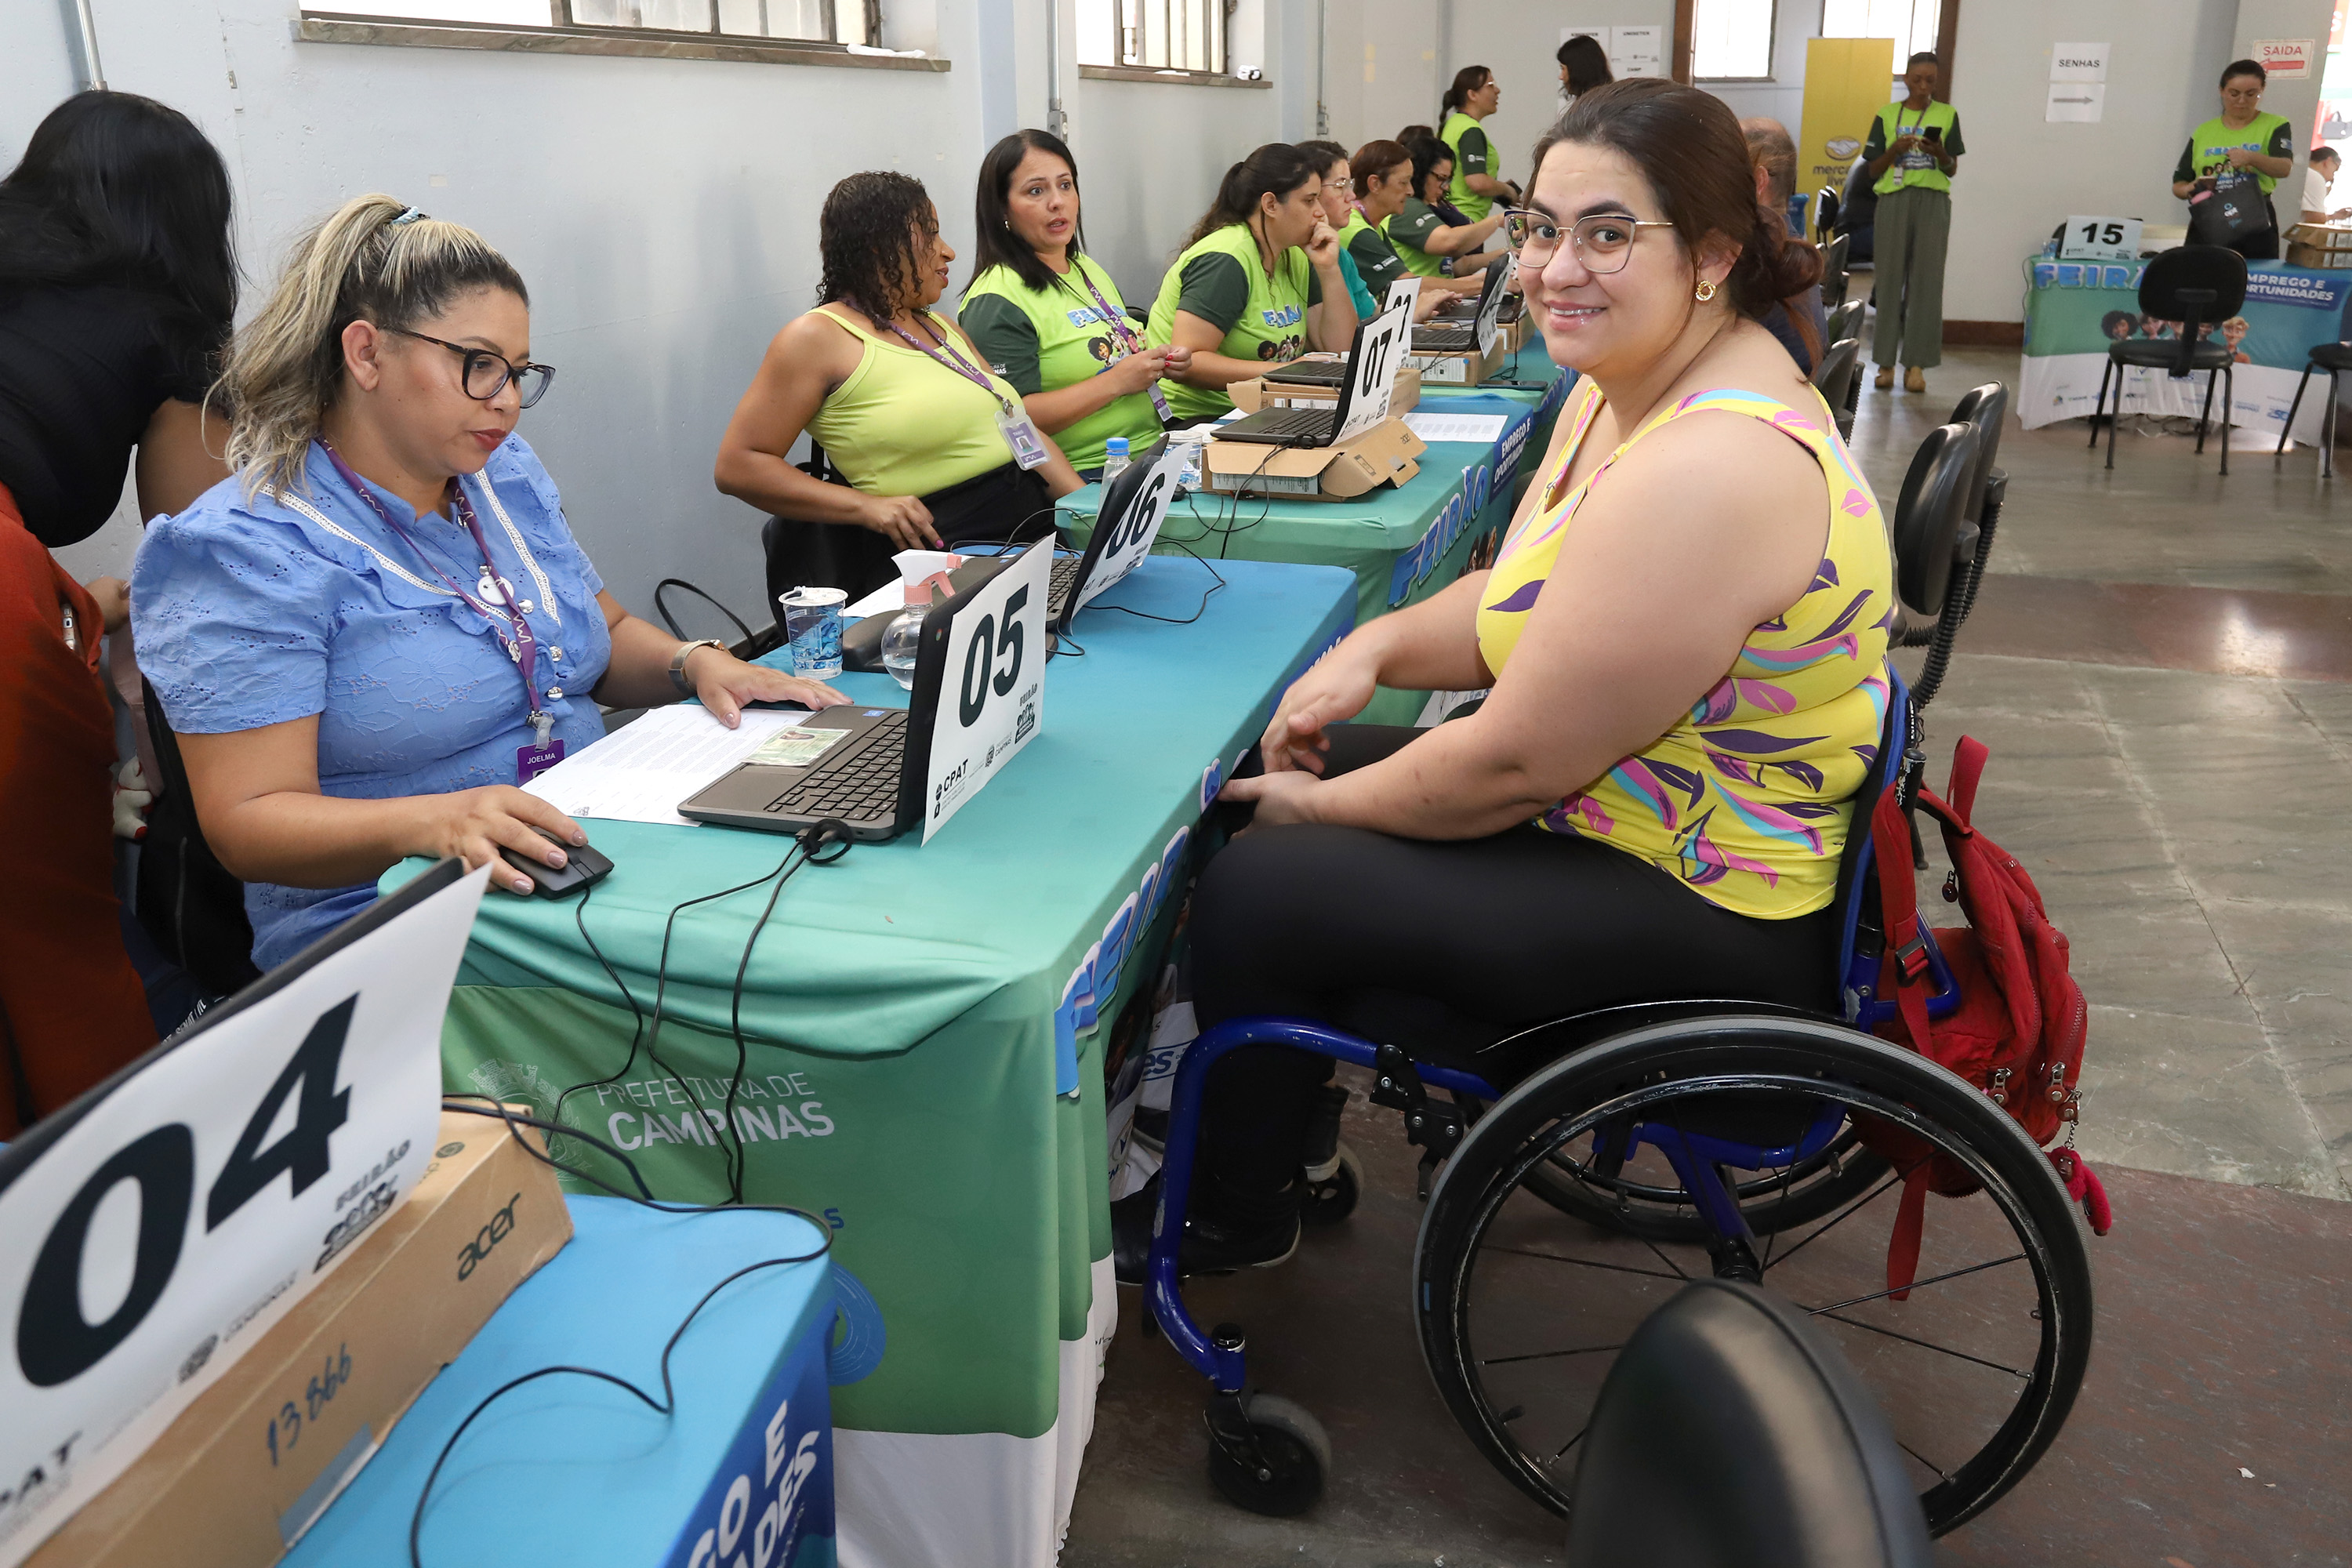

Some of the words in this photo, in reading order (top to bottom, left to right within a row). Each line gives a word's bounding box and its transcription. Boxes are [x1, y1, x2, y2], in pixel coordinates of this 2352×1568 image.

[2058, 58, 2100, 69] SENHAS
[2263, 45, 2303, 56] SAIDA
[2082, 223, 2125, 245] 15
[2033, 261, 2146, 291] FEIR
[2246, 283, 2336, 302] RTUNIDADES
[2247, 272, 2311, 289] MPREGO
[2314, 279, 2326, 290] E
[1362, 326, 1393, 398] 07
[1105, 472, 1166, 560] 06
[1387, 464, 1489, 608] FEIRÃO
[959, 582, 1030, 728] 05
[526, 752, 557, 765] JOELMA
[943, 757, 969, 793] CPAT
[593, 1076, 771, 1108] PREFEITURA
[766, 1071, 816, 1098] DE
[607, 1100, 836, 1152] CAMPINAS
[16, 991, 361, 1388] 04
[458, 1192, 521, 1282] acer
[764, 1399, 788, 1489] E
